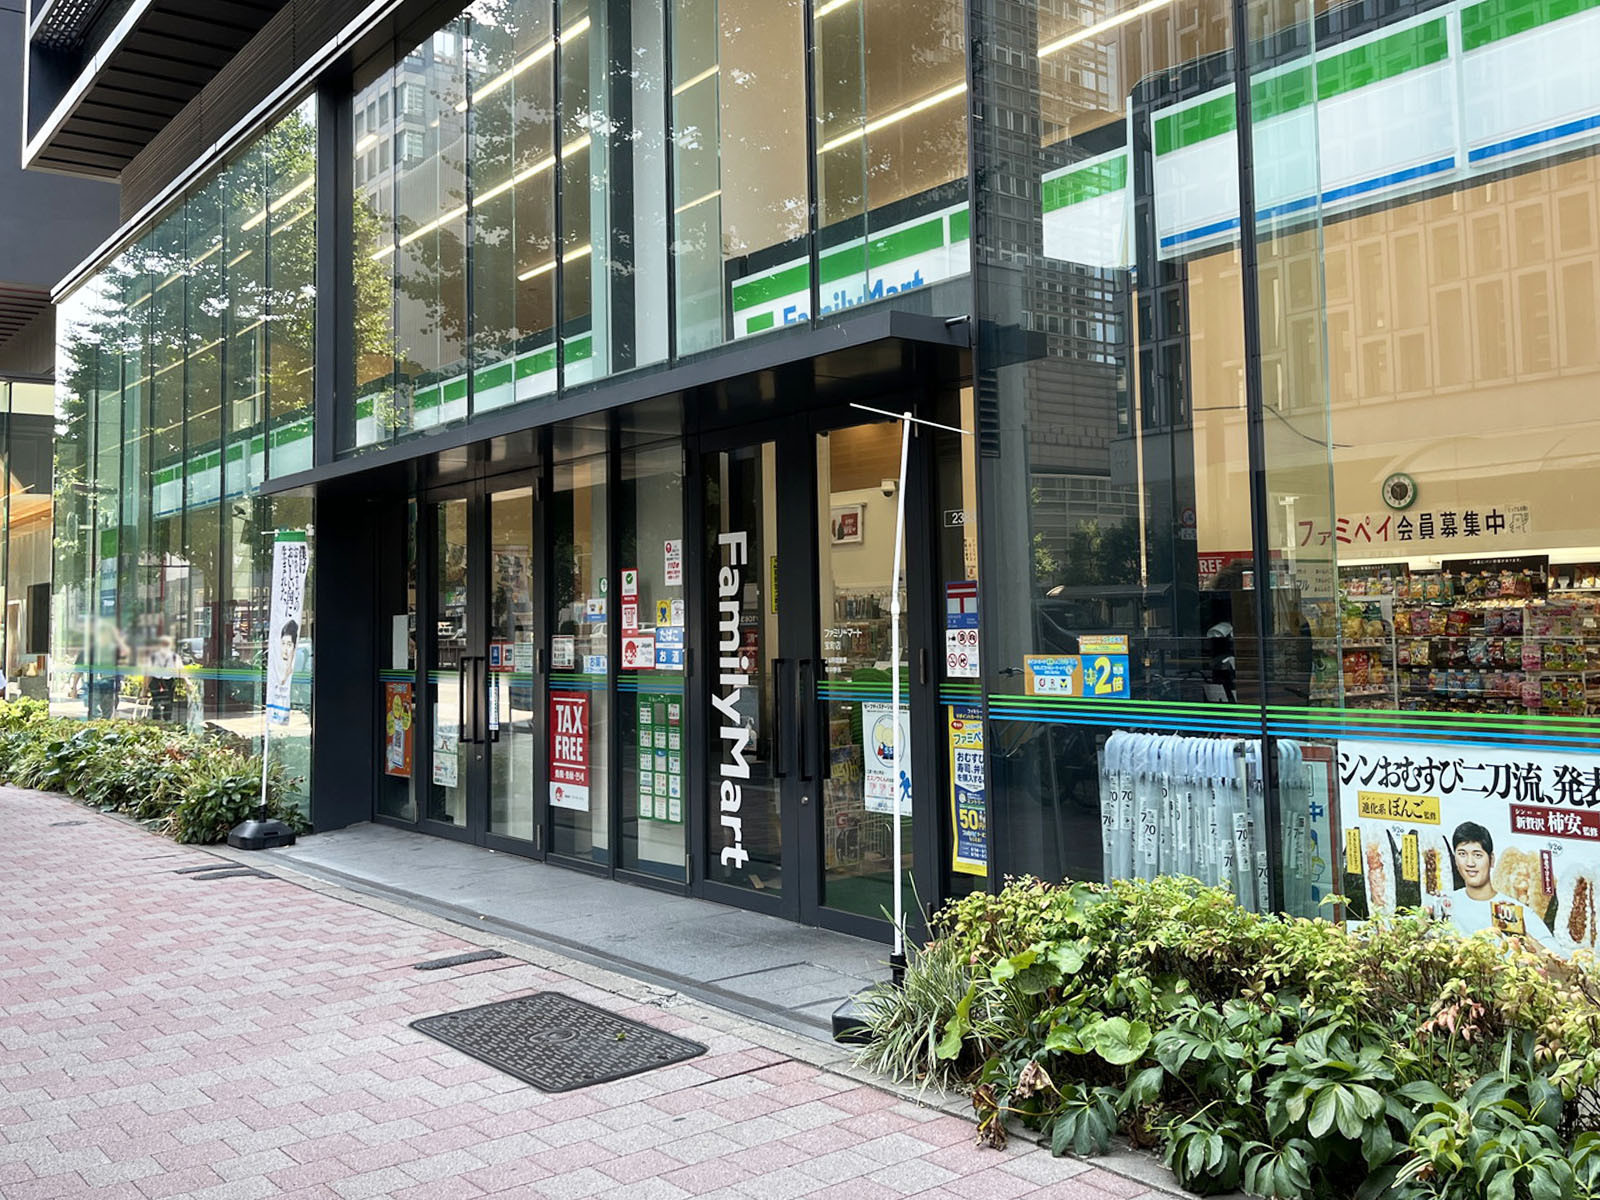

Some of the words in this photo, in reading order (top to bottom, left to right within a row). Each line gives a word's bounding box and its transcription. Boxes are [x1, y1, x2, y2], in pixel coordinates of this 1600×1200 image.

[1298, 509, 1505, 547] ファミペイ会員募集中
[659, 629, 679, 641] たばこ
[824, 628, 862, 638] ファミリーマート
[711, 530, 750, 869] FamilyMart
[556, 705, 583, 734] TAX
[555, 735, 583, 761] FREE
[960, 808, 979, 830] 50
[1236, 830, 1248, 840] 70
